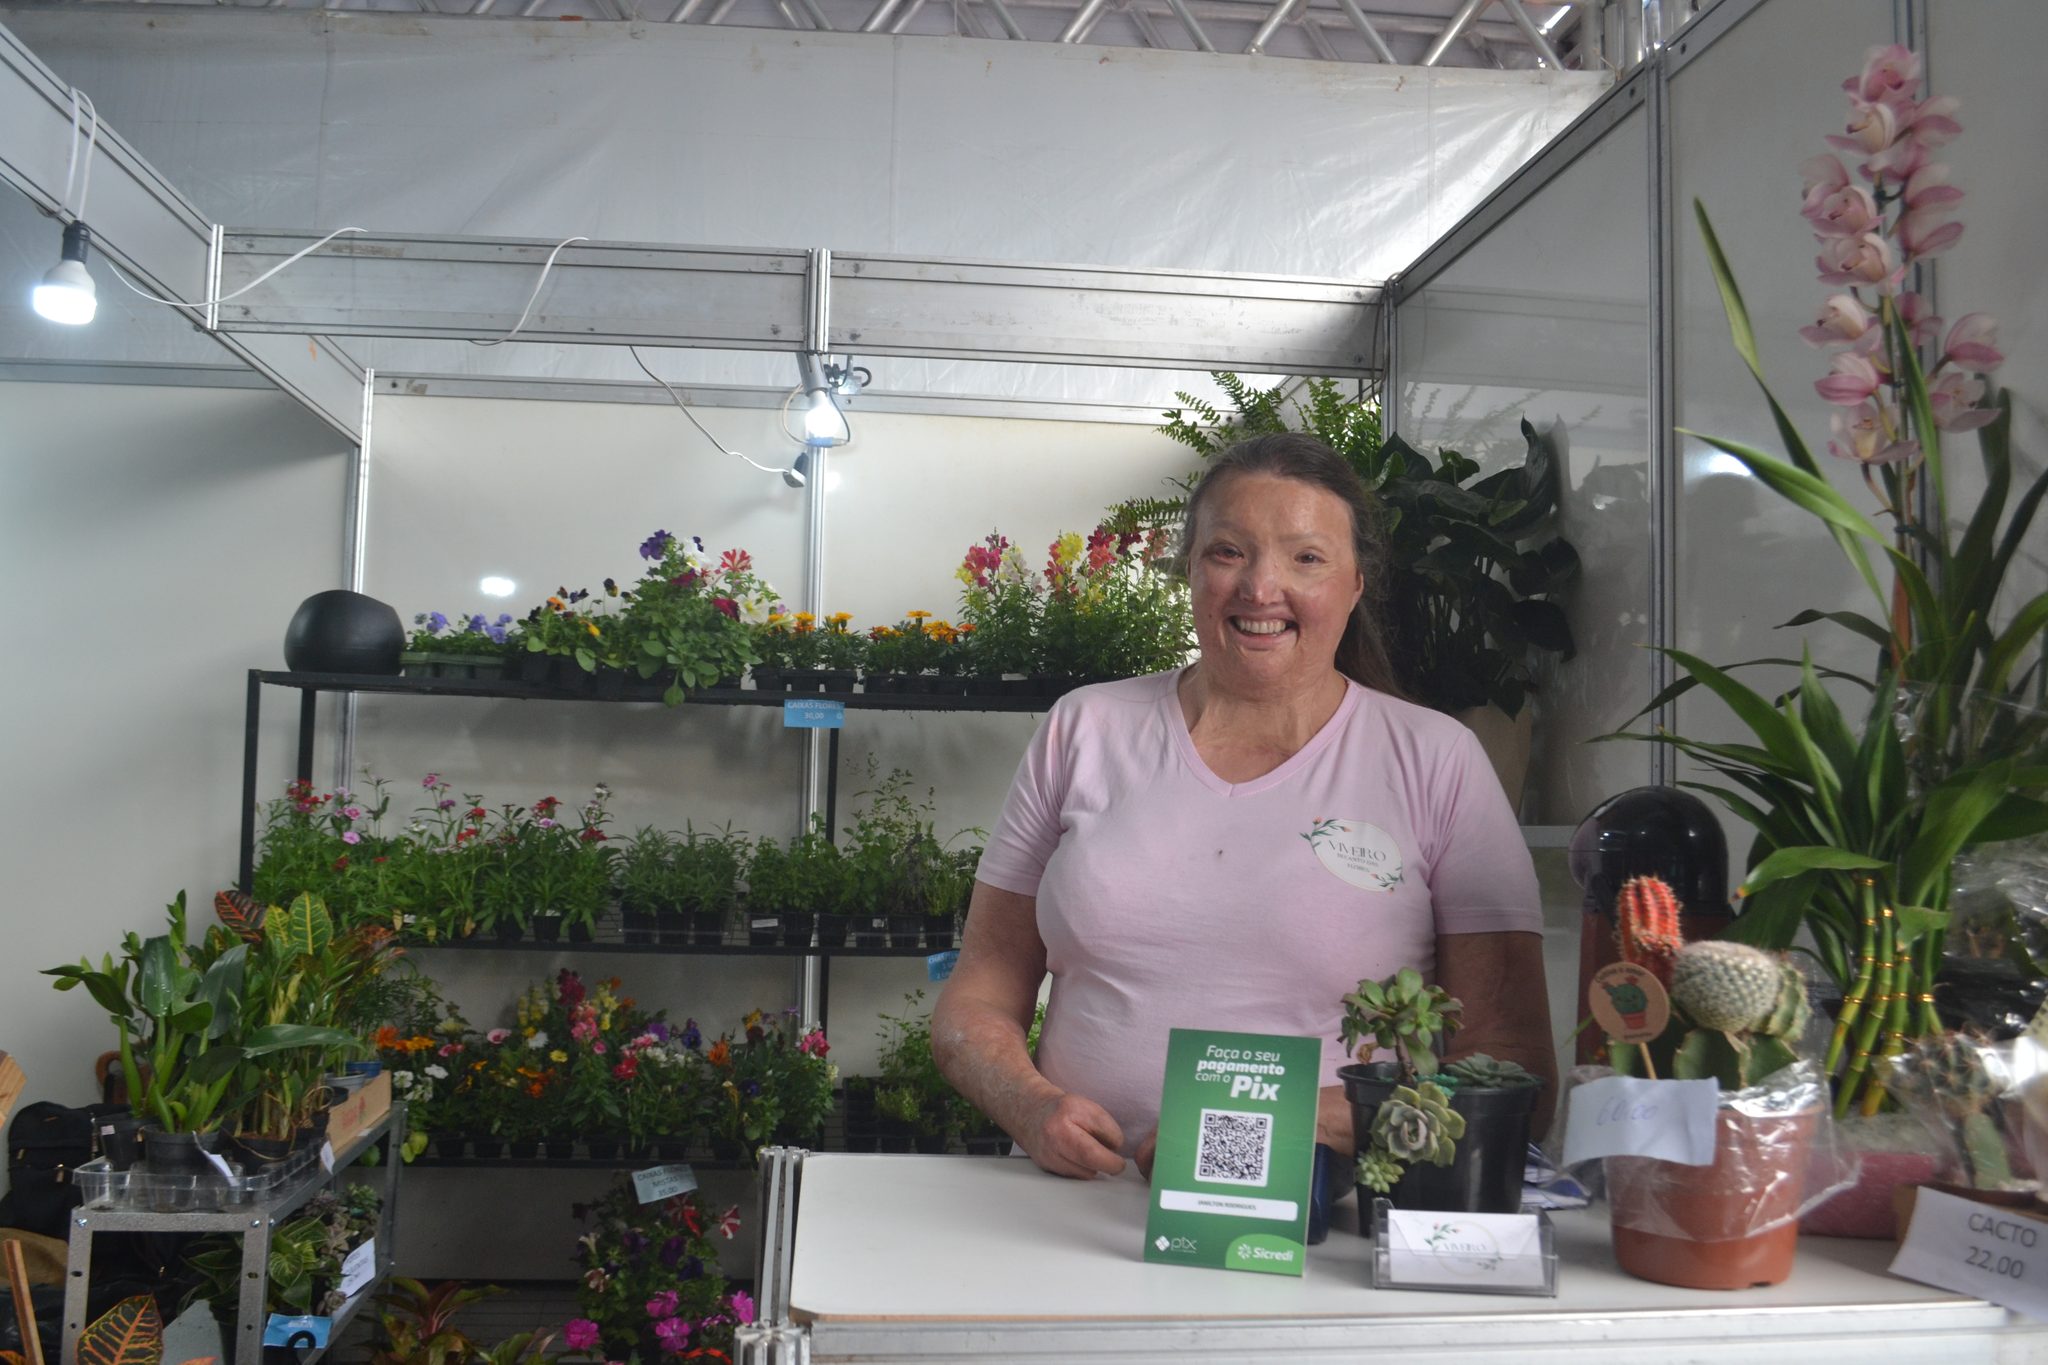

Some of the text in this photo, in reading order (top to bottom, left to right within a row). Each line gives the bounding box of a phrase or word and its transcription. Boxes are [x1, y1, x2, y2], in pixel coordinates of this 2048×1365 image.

[1328, 840, 1387, 862] VIVEIRO
[1206, 1045, 1281, 1062] Faça o seu
[1196, 1060, 1286, 1076] pagamento
[1195, 1072, 1232, 1083] com o
[1230, 1075, 1281, 1102] Pix
[1968, 1212, 2038, 1248] CACTO
[1170, 1236, 1198, 1251] pix
[1252, 1247, 1295, 1262] Sicredi
[1964, 1245, 2025, 1279] 22.00
